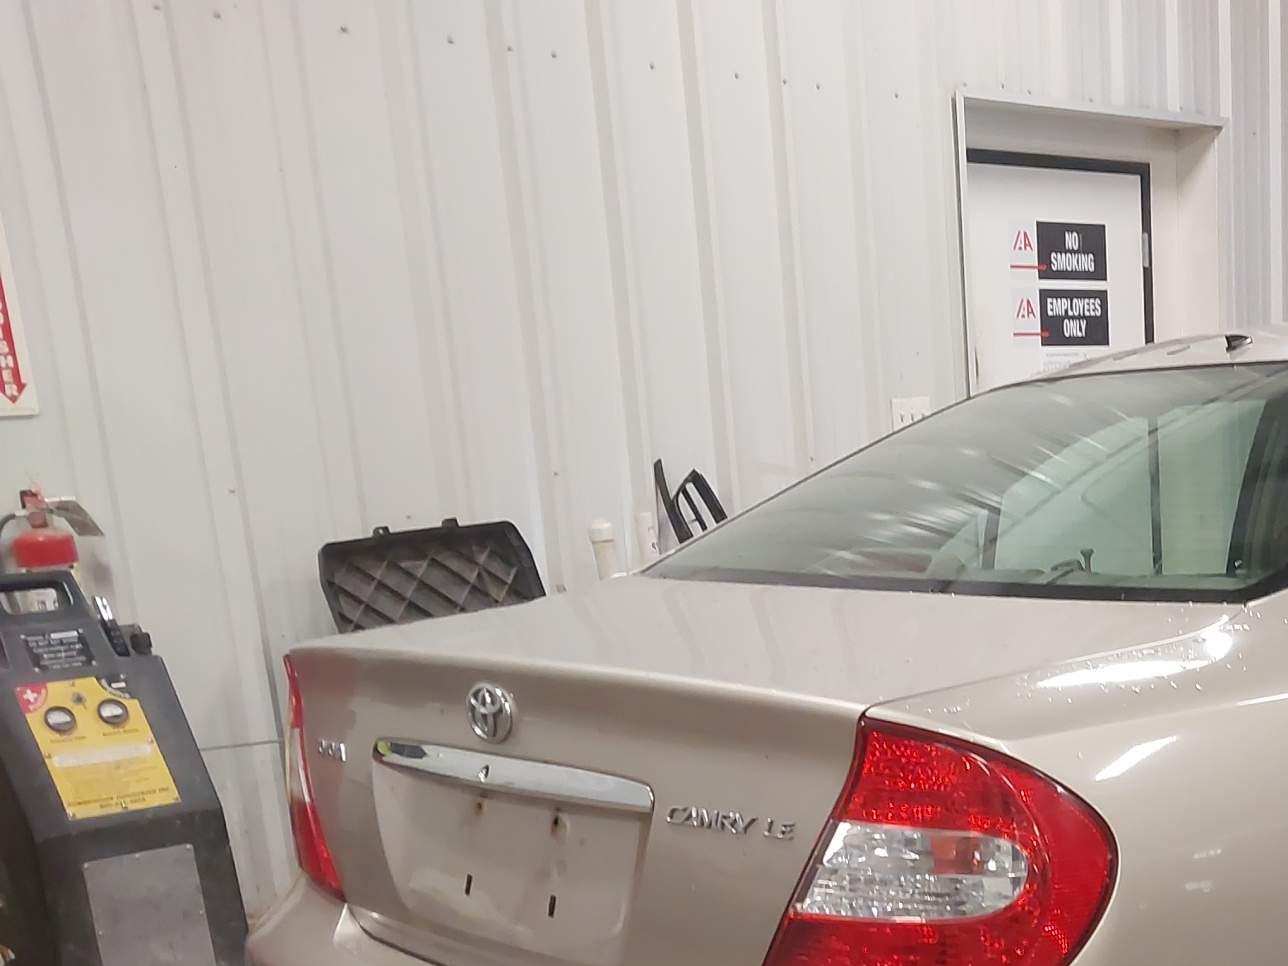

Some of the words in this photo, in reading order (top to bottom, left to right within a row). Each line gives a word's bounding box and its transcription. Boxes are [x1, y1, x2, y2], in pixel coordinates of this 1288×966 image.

[1065, 231, 1079, 250] NO
[1050, 252, 1095, 272] SMOKING
[1047, 297, 1102, 317] EMPLOYEES
[1063, 319, 1087, 337] ONLY
[666, 806, 759, 835] CAMRY
[763, 817, 796, 840] LE
